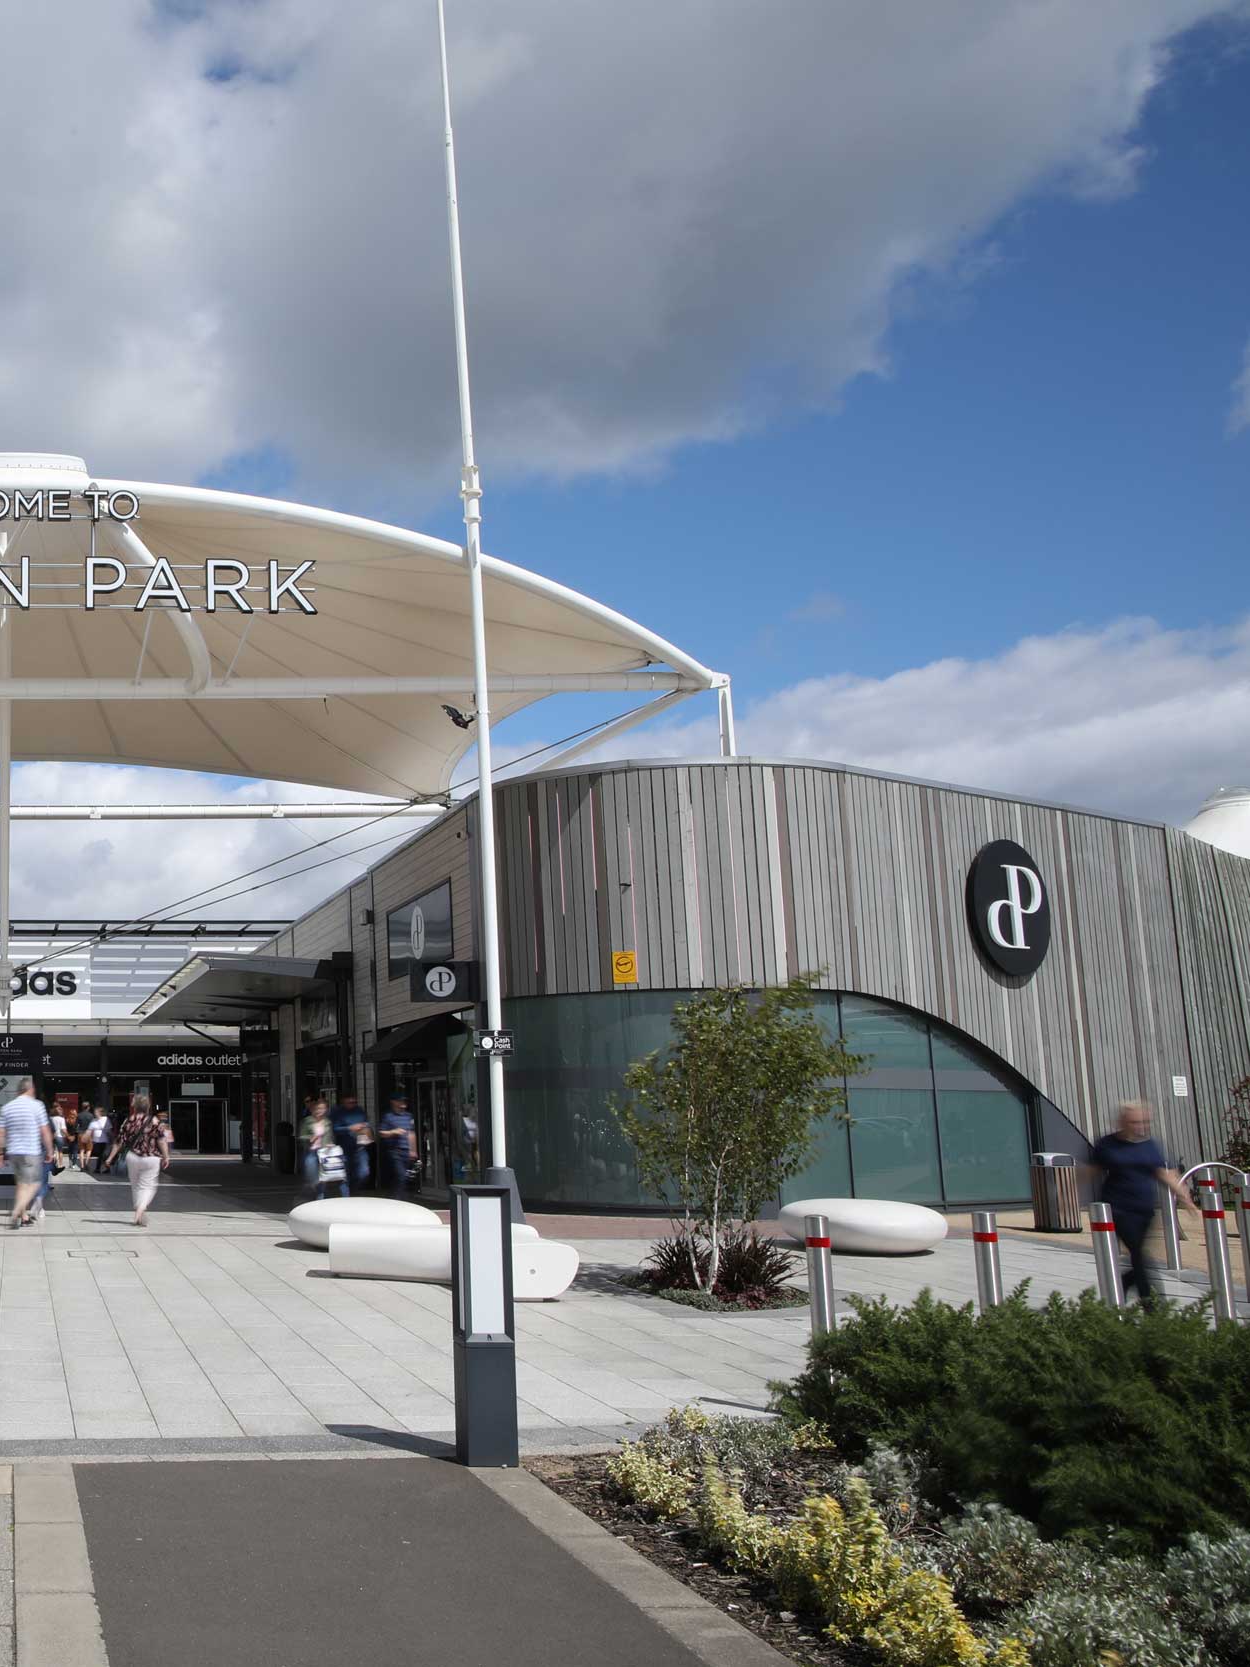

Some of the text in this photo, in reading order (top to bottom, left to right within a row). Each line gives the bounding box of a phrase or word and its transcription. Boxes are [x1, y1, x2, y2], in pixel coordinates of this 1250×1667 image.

[84, 489, 140, 522] TO
[84, 556, 319, 615] PARK
[157, 1053, 242, 1066] adidas outlet
